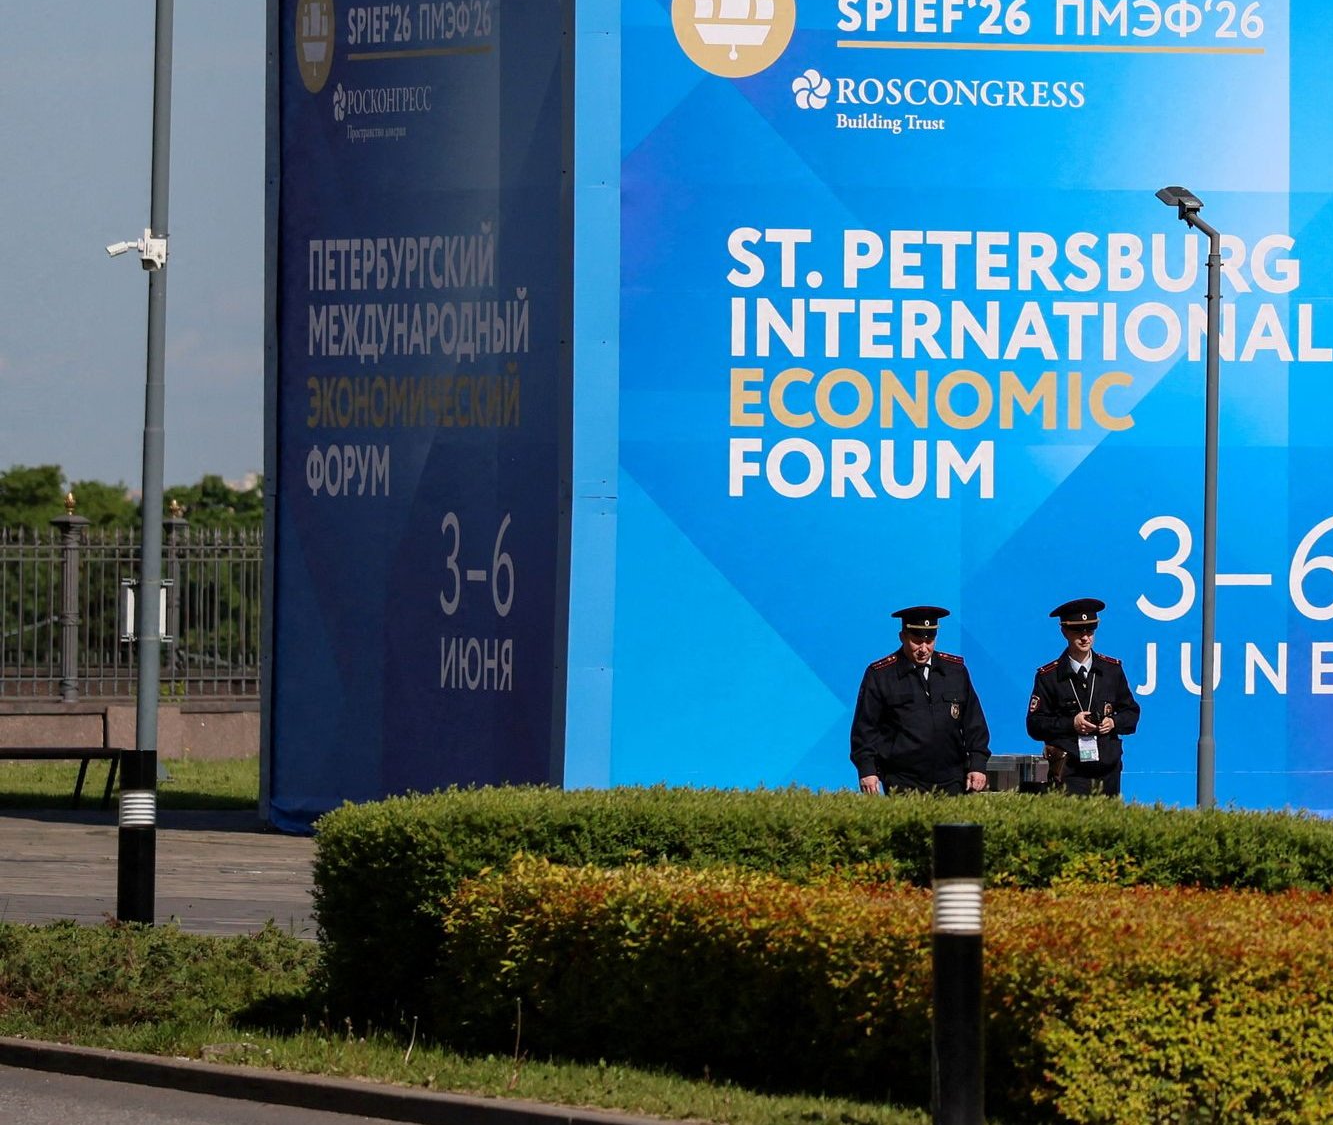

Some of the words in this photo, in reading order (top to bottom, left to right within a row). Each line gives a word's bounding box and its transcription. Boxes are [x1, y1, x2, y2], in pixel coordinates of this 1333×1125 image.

[347, 86, 432, 115] РОСКОНГРЕСС
[836, 76, 1085, 108] ROSCONGRESS
[836, 113, 902, 134] Building
[905, 114, 945, 131] Trust
[309, 221, 494, 291] ПЕТЕРБУРГСКИЙ
[726, 227, 822, 289] ST.
[843, 229, 1300, 294] PETERSBURG
[308, 286, 530, 364] МЕЖДУНАРОДНЫЙ
[730, 297, 1333, 362] INTERNATIONAL
[306, 362, 520, 428] ЭКОНОМИЧЕСКИЙ
[729, 368, 1135, 432] ECONOMIC
[305, 444, 390, 497] ФОРУМ
[729, 437, 994, 500] FORUM
[440, 637, 513, 692] ИЮНЯ
